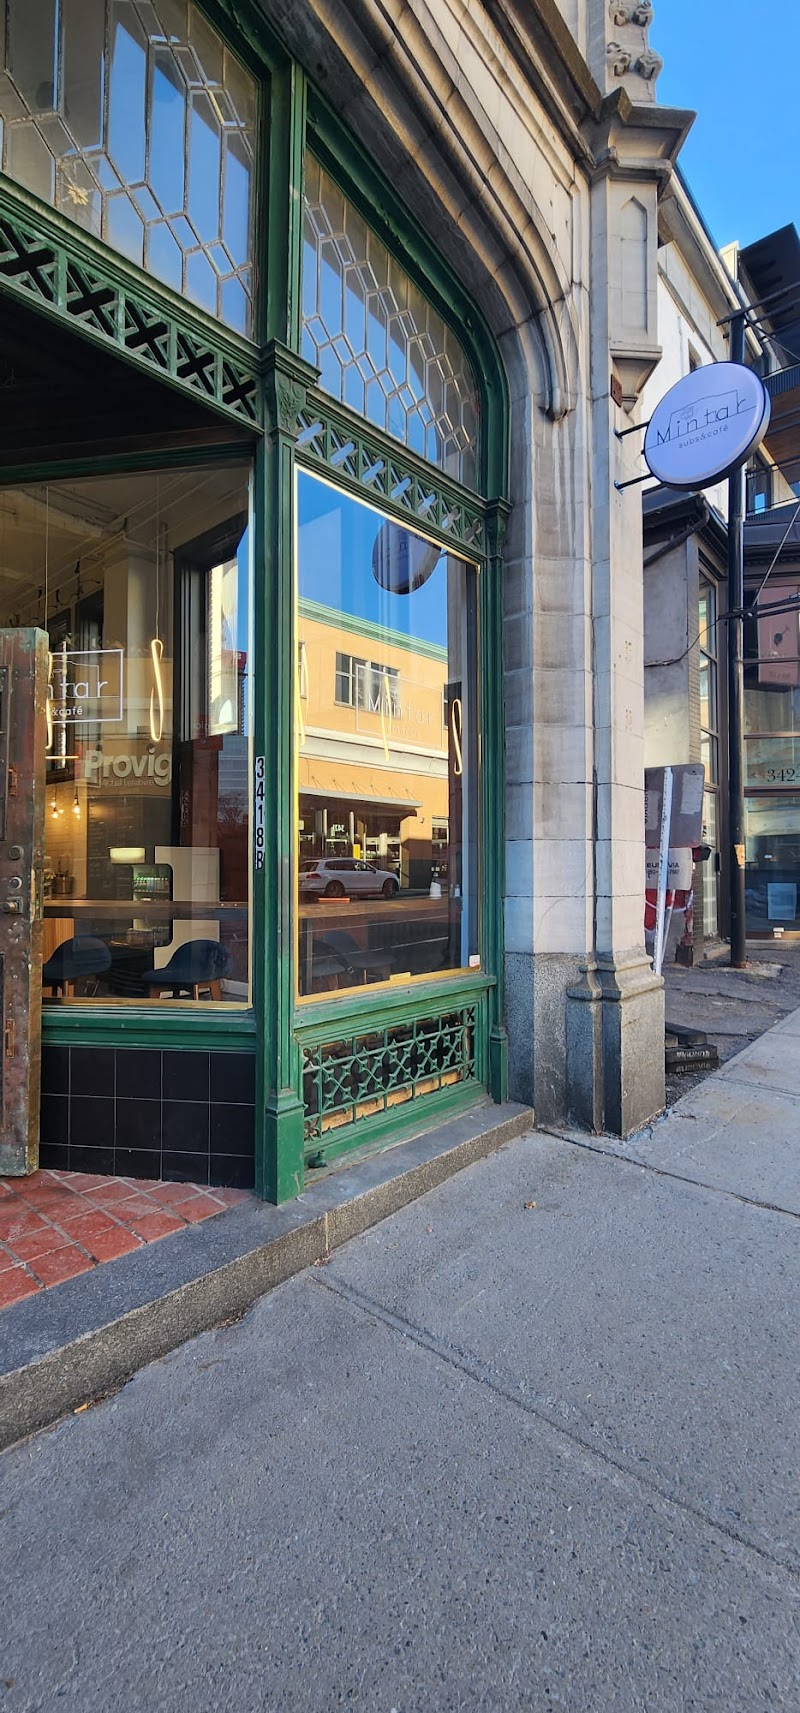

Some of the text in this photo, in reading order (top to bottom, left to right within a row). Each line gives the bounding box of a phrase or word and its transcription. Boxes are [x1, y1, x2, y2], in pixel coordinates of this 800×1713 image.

[657, 398, 747, 446] Mintar
[679, 424, 729, 449] subs&café
[256, 757, 265, 869] 3418B
